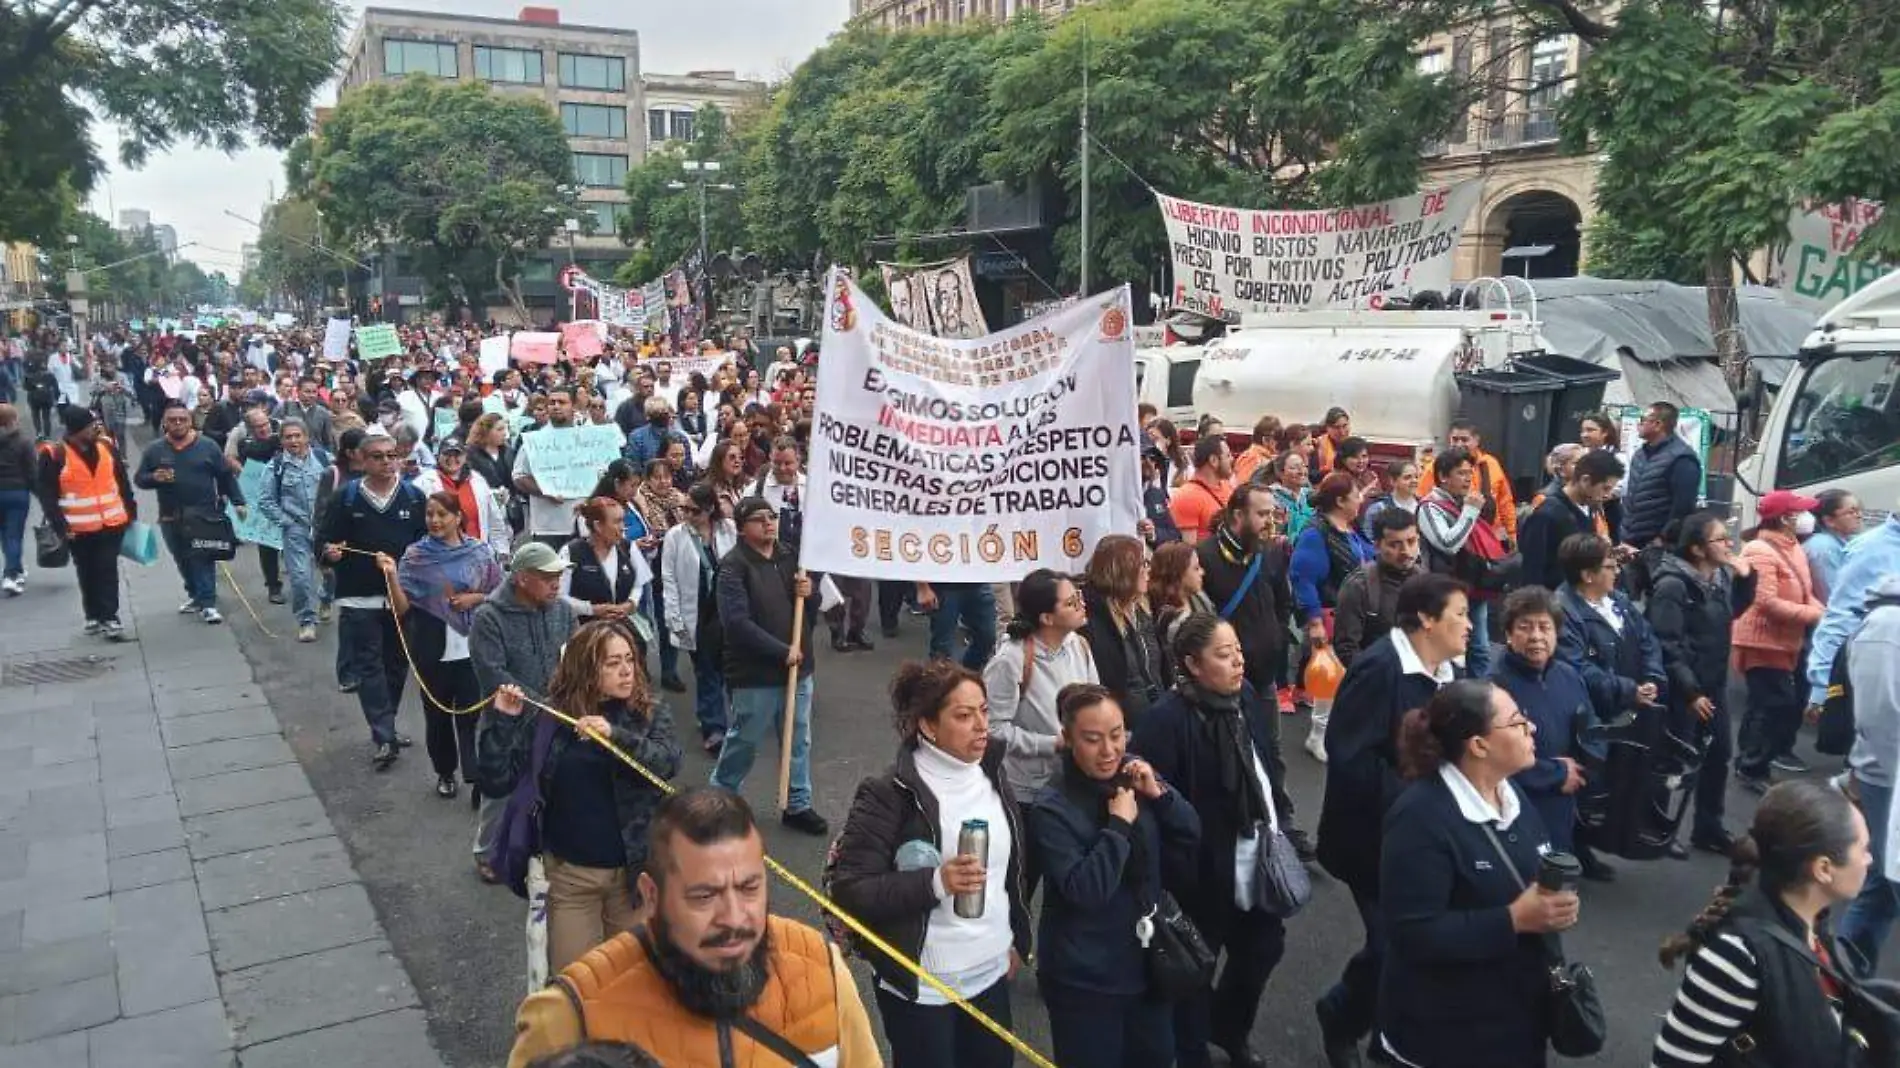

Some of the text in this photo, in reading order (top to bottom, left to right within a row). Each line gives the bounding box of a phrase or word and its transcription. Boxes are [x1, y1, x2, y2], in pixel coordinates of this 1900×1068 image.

[1252, 204, 1394, 235] INCONDICIONAL
[1420, 188, 1454, 217] DE
[1187, 225, 1241, 254] HIGINIO
[1253, 235, 1318, 258] BUSTOS
[1174, 241, 1212, 271] PRESO
[1225, 254, 1252, 279] POR
[1269, 257, 1346, 282] MOTIVOS
[1194, 269, 1220, 294] DEL
[1234, 277, 1313, 306] GOBIERNO
[1007, 424, 1023, 444] A
[1117, 423, 1135, 446] A
[829, 449, 1109, 496] NUESTRAS CONDICIONES
[830, 480, 1106, 516] GENERALES DE TRABAJO
[851, 523, 1084, 564] SECCIÓN 6
